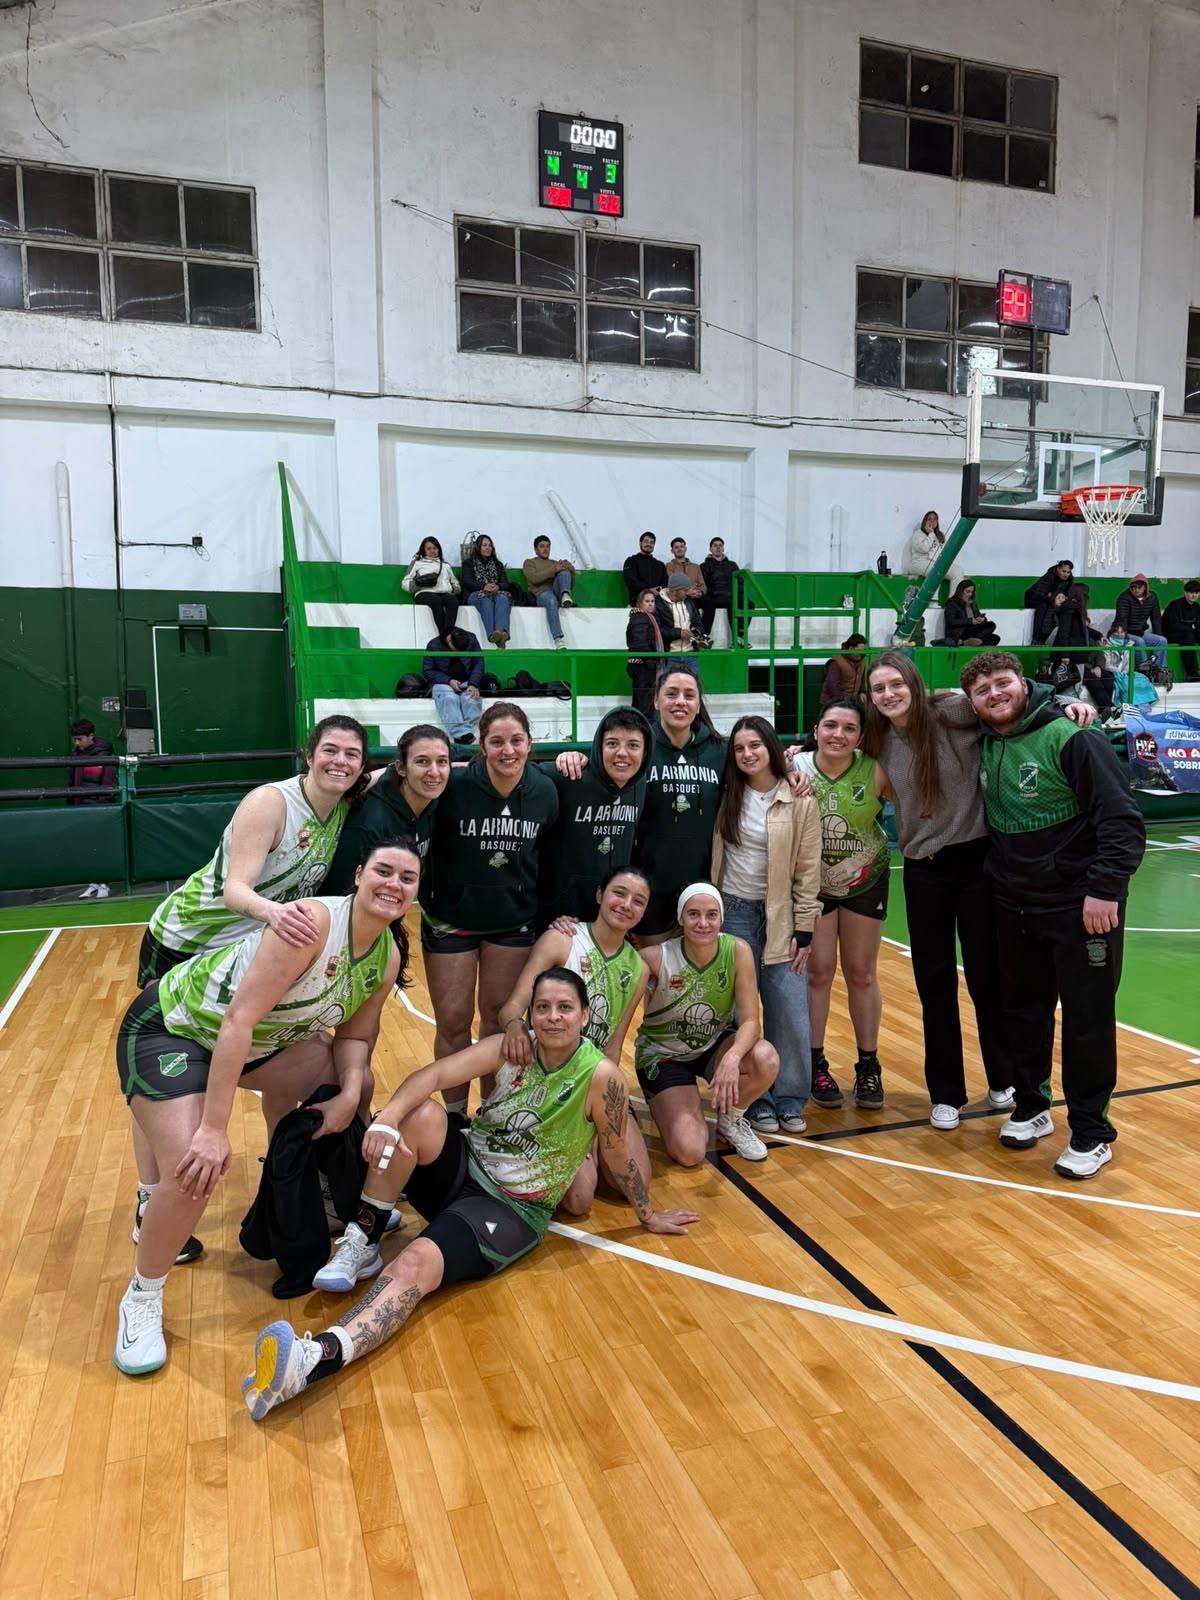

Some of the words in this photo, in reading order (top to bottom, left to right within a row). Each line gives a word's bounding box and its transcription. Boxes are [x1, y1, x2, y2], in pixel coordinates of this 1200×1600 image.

[547, 156, 559, 175] 4
[606, 164, 616, 183] 3
[577, 169, 588, 189] 4
[1003, 287, 1027, 318] 24
[646, 765, 658, 783] A
[662, 764, 719, 784] ARMONIA
[828, 792, 838, 811] 6
[574, 806, 593, 822] LA
[460, 819, 476, 837] LA
[696, 980, 704, 999] 5
[526, 1084, 547, 1108] 10
